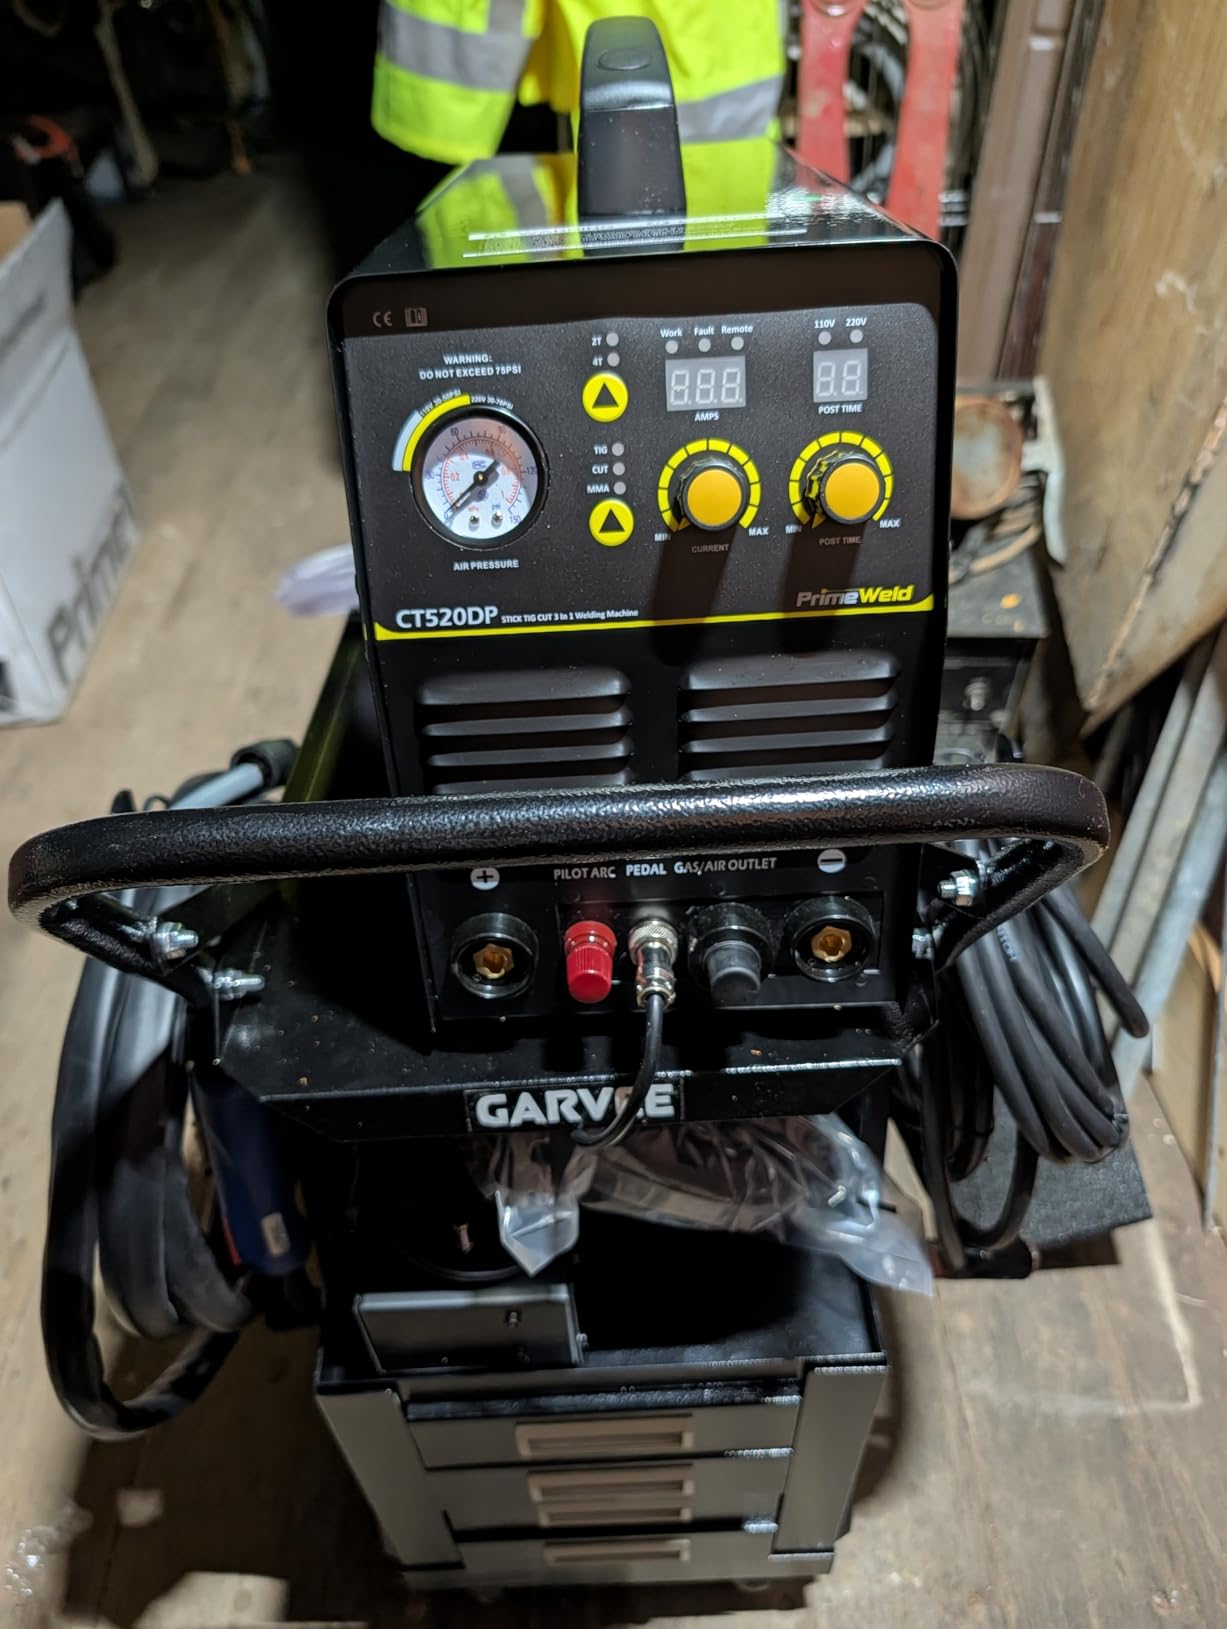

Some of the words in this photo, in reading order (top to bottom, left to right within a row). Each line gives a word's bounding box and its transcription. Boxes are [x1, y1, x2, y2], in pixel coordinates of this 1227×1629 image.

[814, 319, 836, 329] 110V
[845, 317, 868, 327] 220V
[660, 328, 683, 338] Work
[694, 325, 715, 336] Fault
[721, 324, 753, 335] Remote
[592, 336, 602, 347] 2T
[592, 356, 603, 367] 4T
[419, 370, 434, 380] DO
[435, 369, 454, 379] NOT
[456, 366, 494, 378] EXCEED
[495, 365, 522, 376] 75PSI
[818, 404, 840, 414] POST
[841, 403, 863, 413] TIME
[694, 411, 719, 422] AMPS
[592, 444, 608, 455] TIG
[592, 464, 609, 474] CUT
[586, 483, 610, 494] MMA
[879, 518, 901, 529] MAX
[654, 531, 671, 542] MIN
[748, 526, 769, 537] MAX
[819, 537, 841, 546] POST
[843, 536, 862, 545] TIME
[691, 544, 729, 553] CURRENT
[453, 561, 470, 571] AIR
[471, 559, 520, 571] PRESSURE
[796, 584, 914, 608] PrimeWeld
[395, 605, 498, 629] CT520DP
[501, 615, 523, 624] STICK
[523, 614, 536, 623] TIG
[537, 613, 552, 622] CUT
[575, 610, 605, 620] Welding
[606, 608, 639, 618] Machine
[553, 867, 588, 880] PILOT
[590, 865, 616, 879] ARC
[625, 862, 667, 877] PEDAL
[674, 859, 726, 876] GAS/AIR
[727, 857, 777, 870] OUTLET
